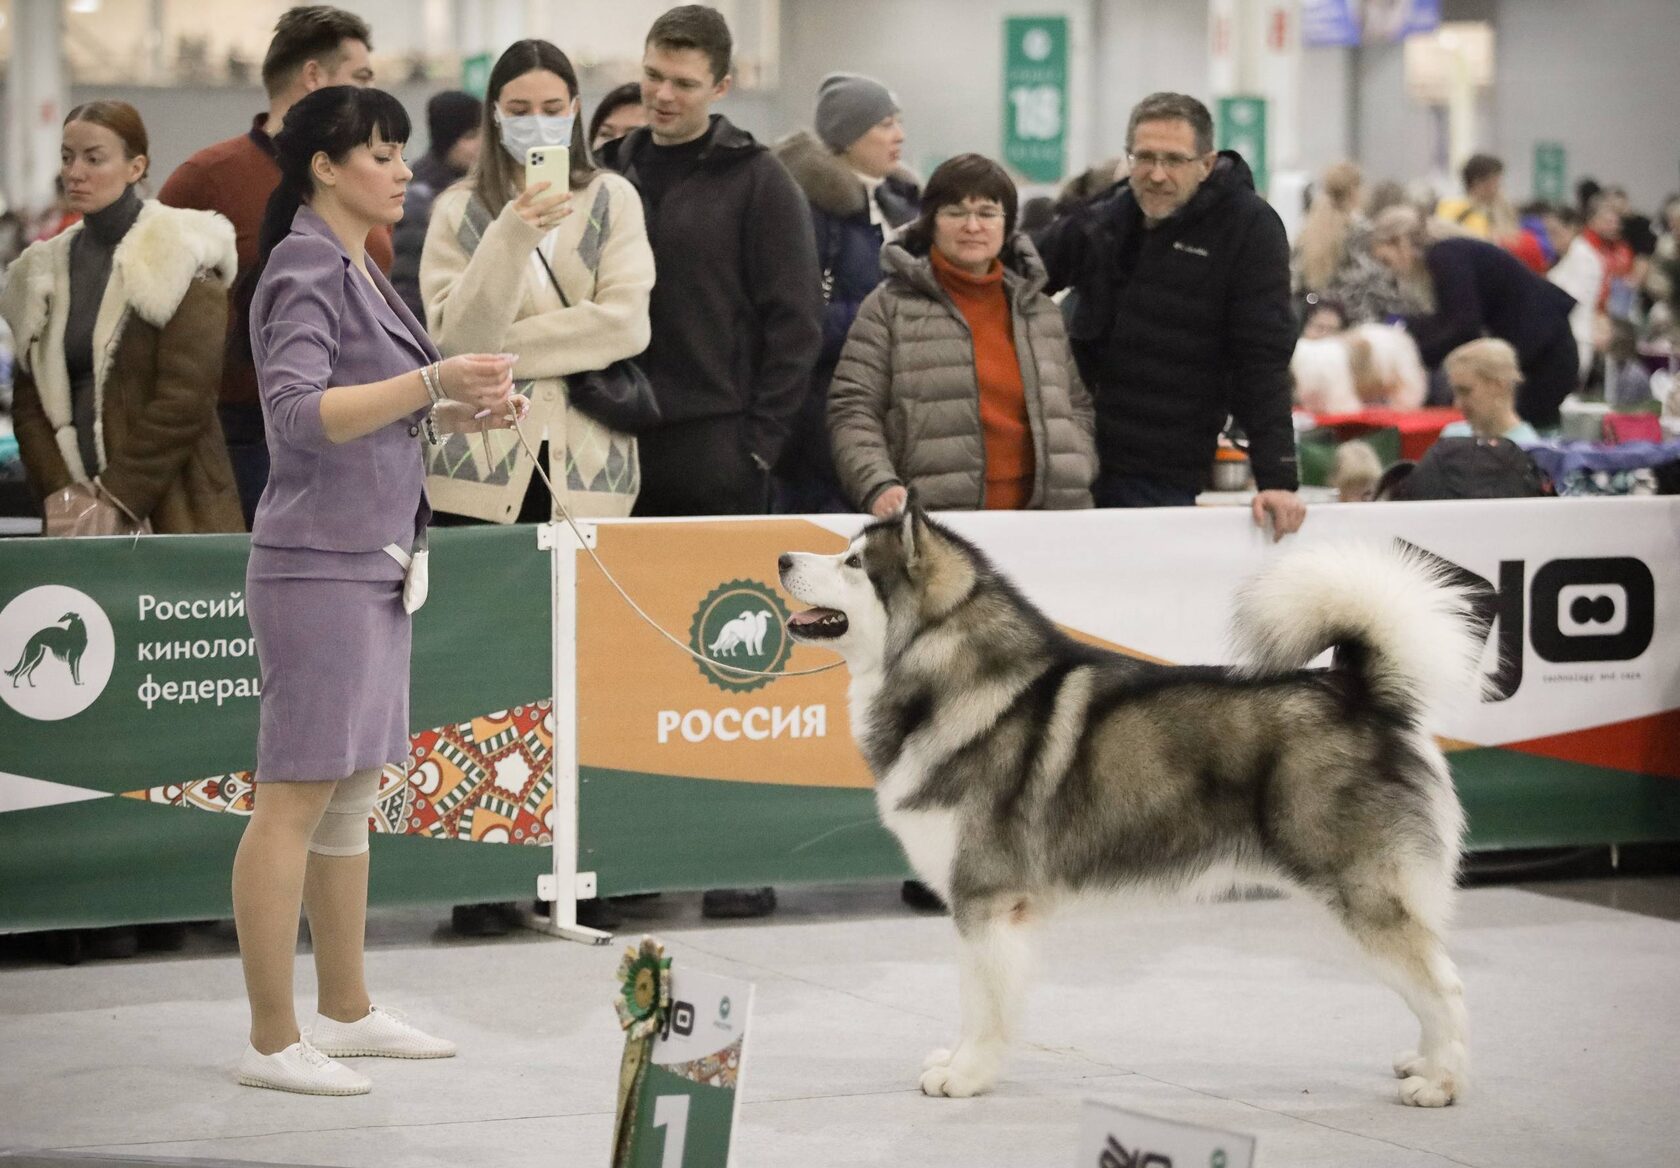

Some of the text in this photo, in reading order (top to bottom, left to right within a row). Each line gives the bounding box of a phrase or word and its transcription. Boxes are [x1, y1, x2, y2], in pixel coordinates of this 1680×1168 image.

[138, 592, 245, 621] Россий
[1600, 671, 1616, 680] and
[657, 704, 826, 744] РОССИЯ
[653, 1094, 690, 1168] 1
